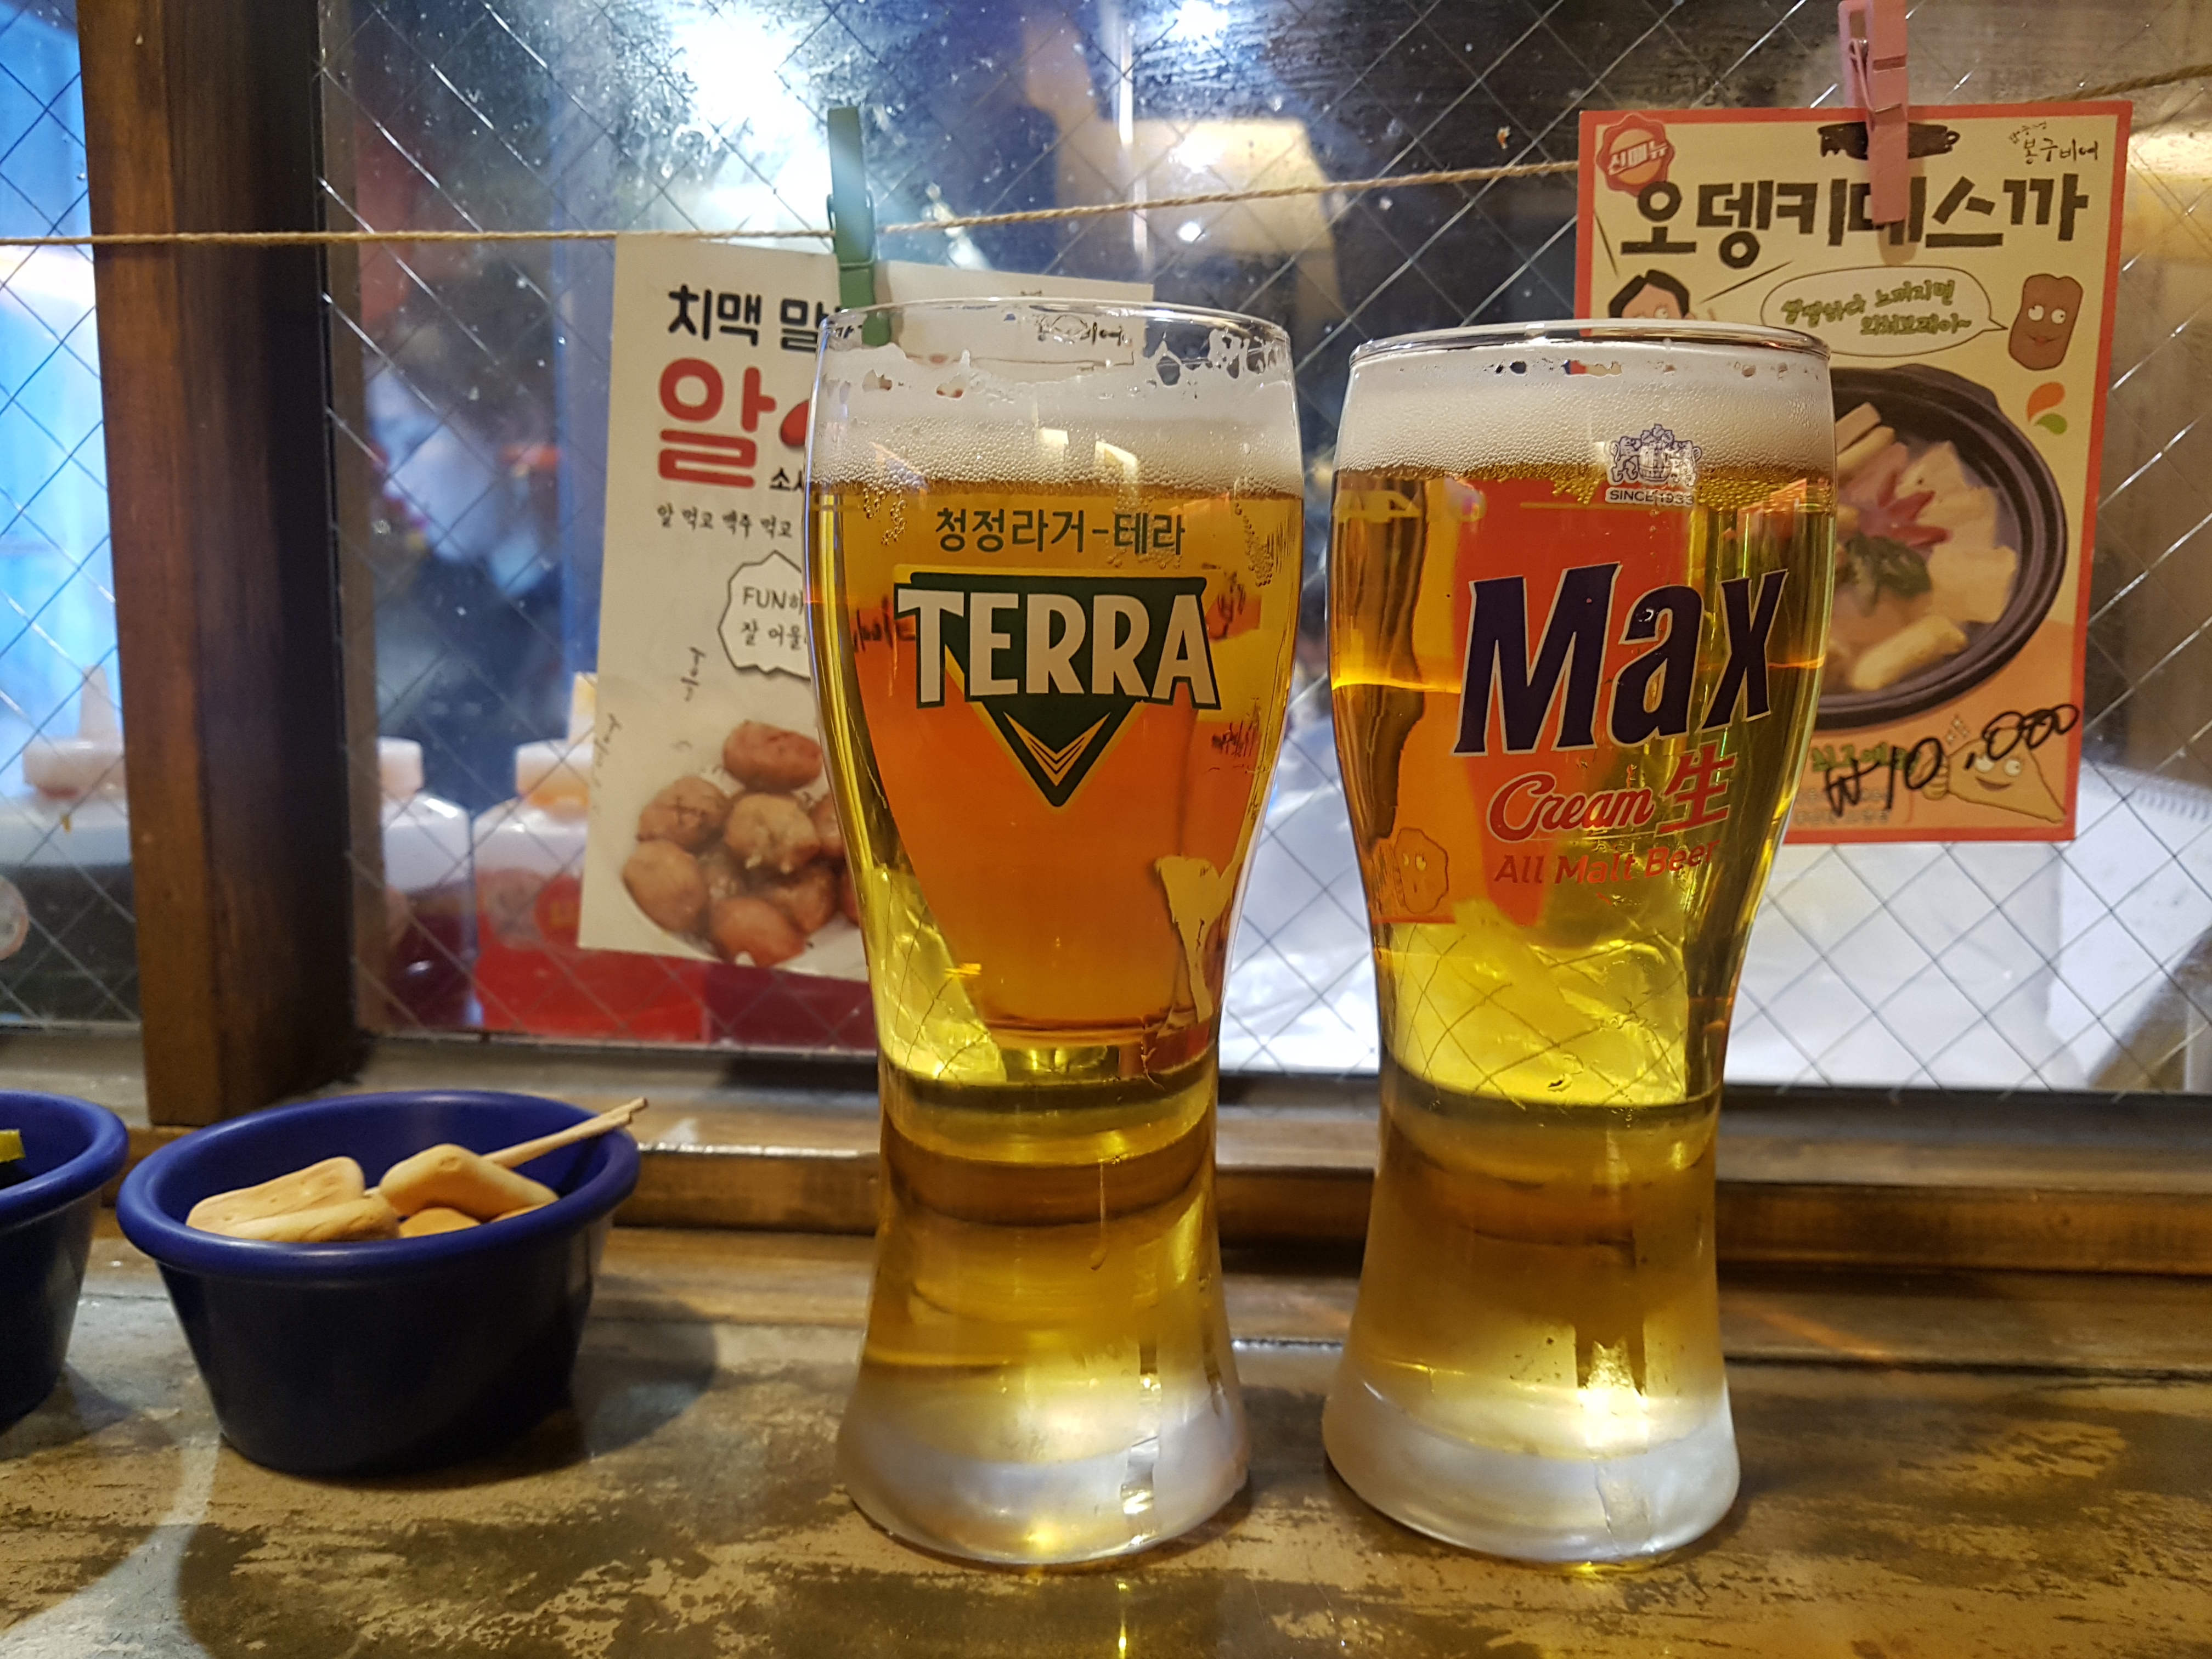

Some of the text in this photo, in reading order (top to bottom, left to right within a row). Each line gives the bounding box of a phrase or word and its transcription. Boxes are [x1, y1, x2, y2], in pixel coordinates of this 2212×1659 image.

[1607, 140, 1668, 176] 신메뉴
[2024, 138, 2099, 165] 봉구비어
[667, 284, 761, 347] 치맥
[780, 298, 840, 353] 말
[1610, 489, 1654, 503] SINCE
[935, 507, 1186, 555] 청정라거-테라
[894, 583, 1221, 710] TERRA
[1453, 561, 1788, 756] Max
[1486, 771, 1655, 843] Cream
[1654, 743, 1737, 836] 生
[1493, 838, 1722, 885] All Malt Beer
